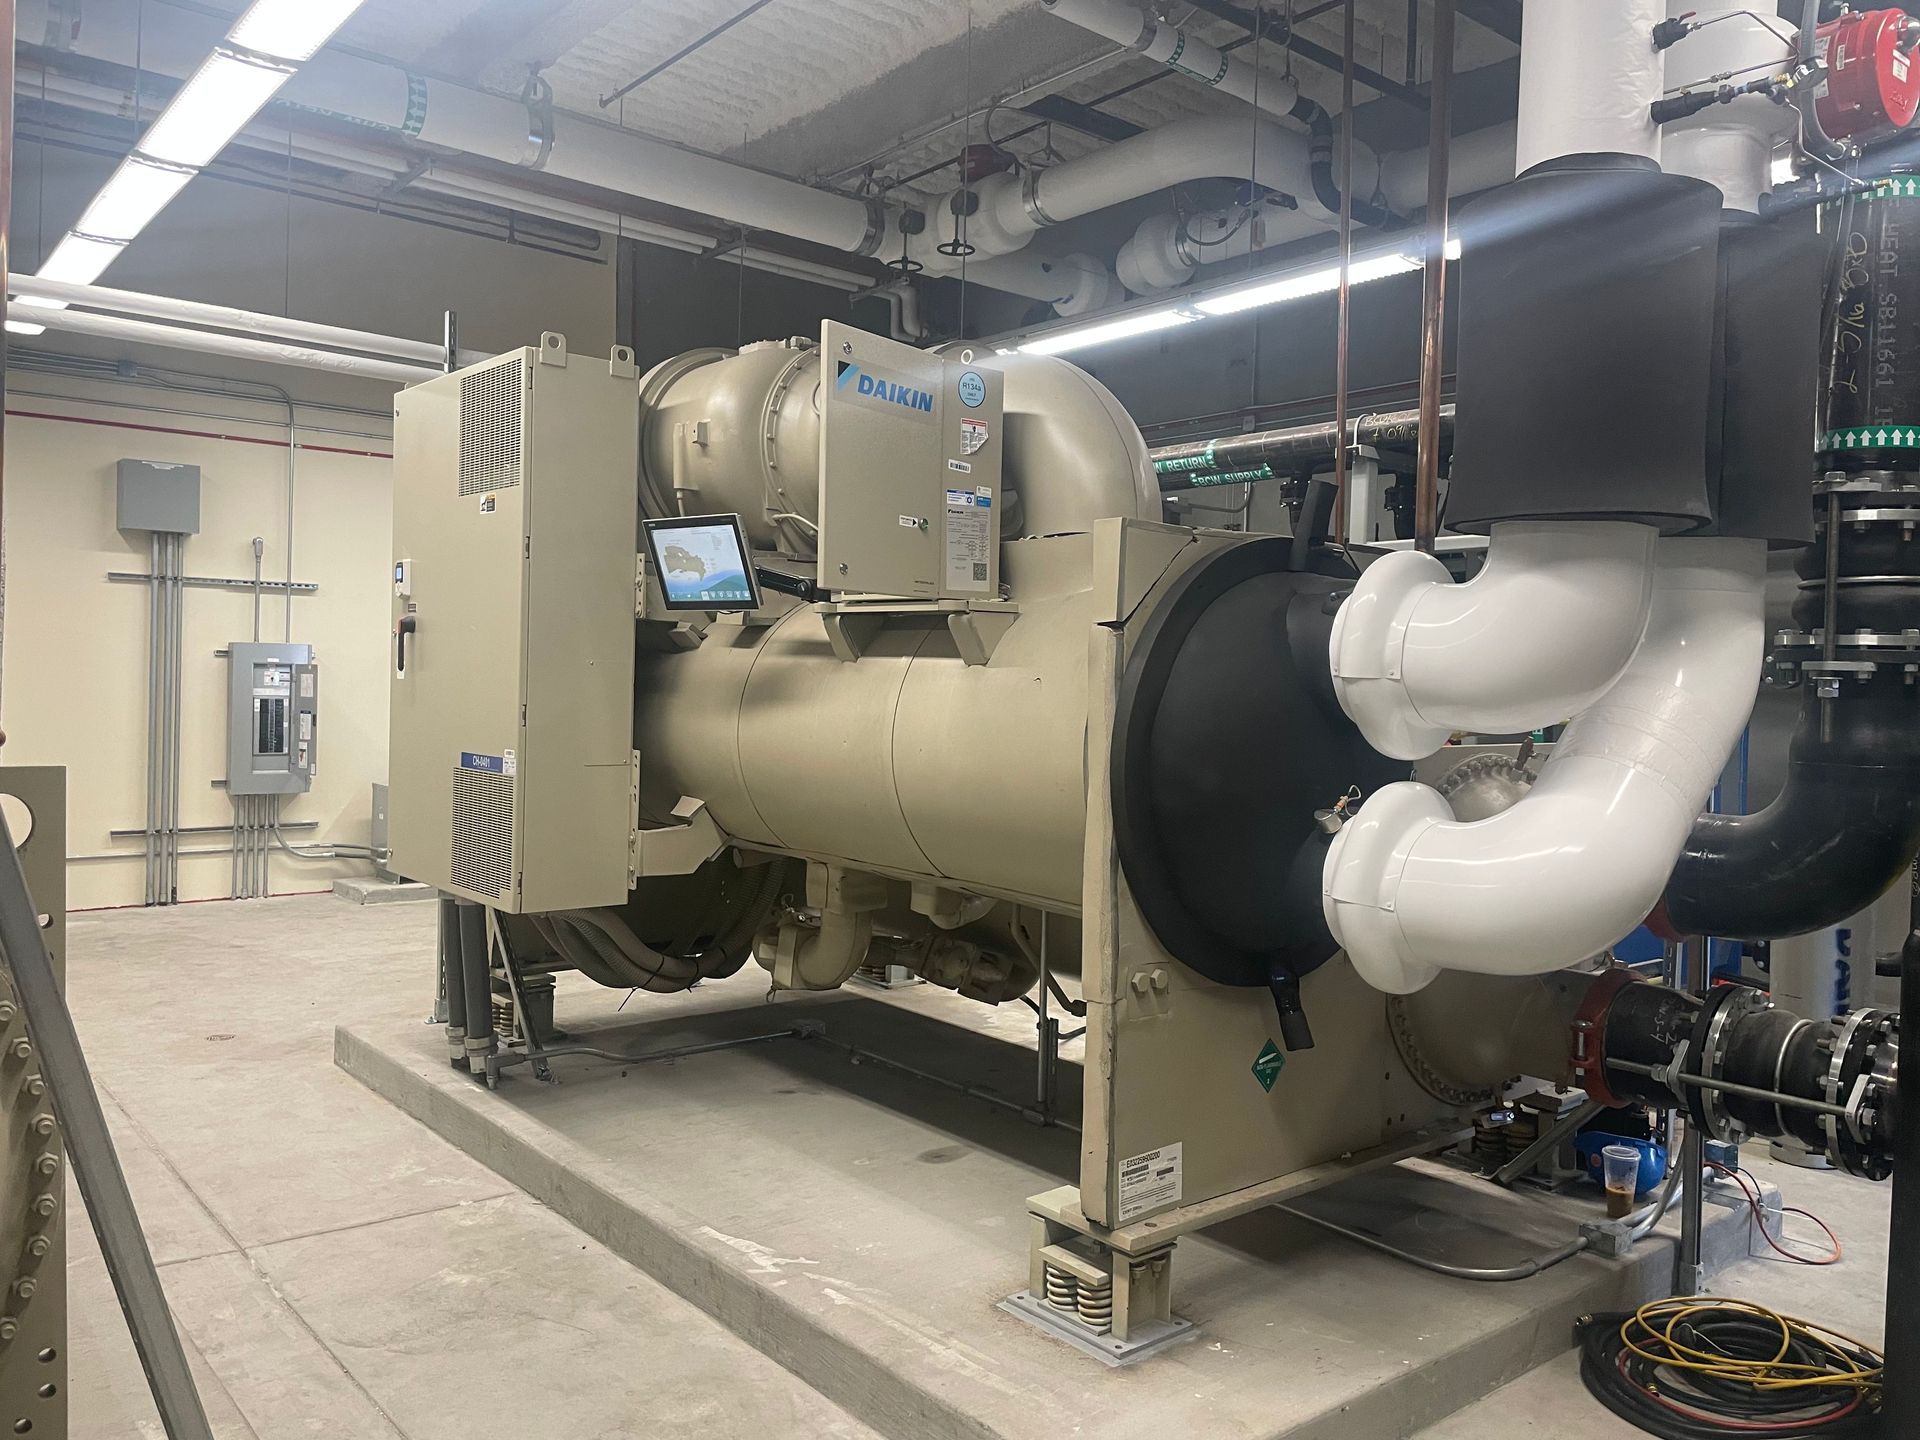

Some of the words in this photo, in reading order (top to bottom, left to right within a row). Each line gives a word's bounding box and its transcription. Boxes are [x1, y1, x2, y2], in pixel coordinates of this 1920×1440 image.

[857, 374, 933, 412] DAIKIN
[1167, 458, 1207, 472] RETURN
[1198, 476, 1221, 487] BCW
[1225, 470, 1263, 482] SUPPLY
